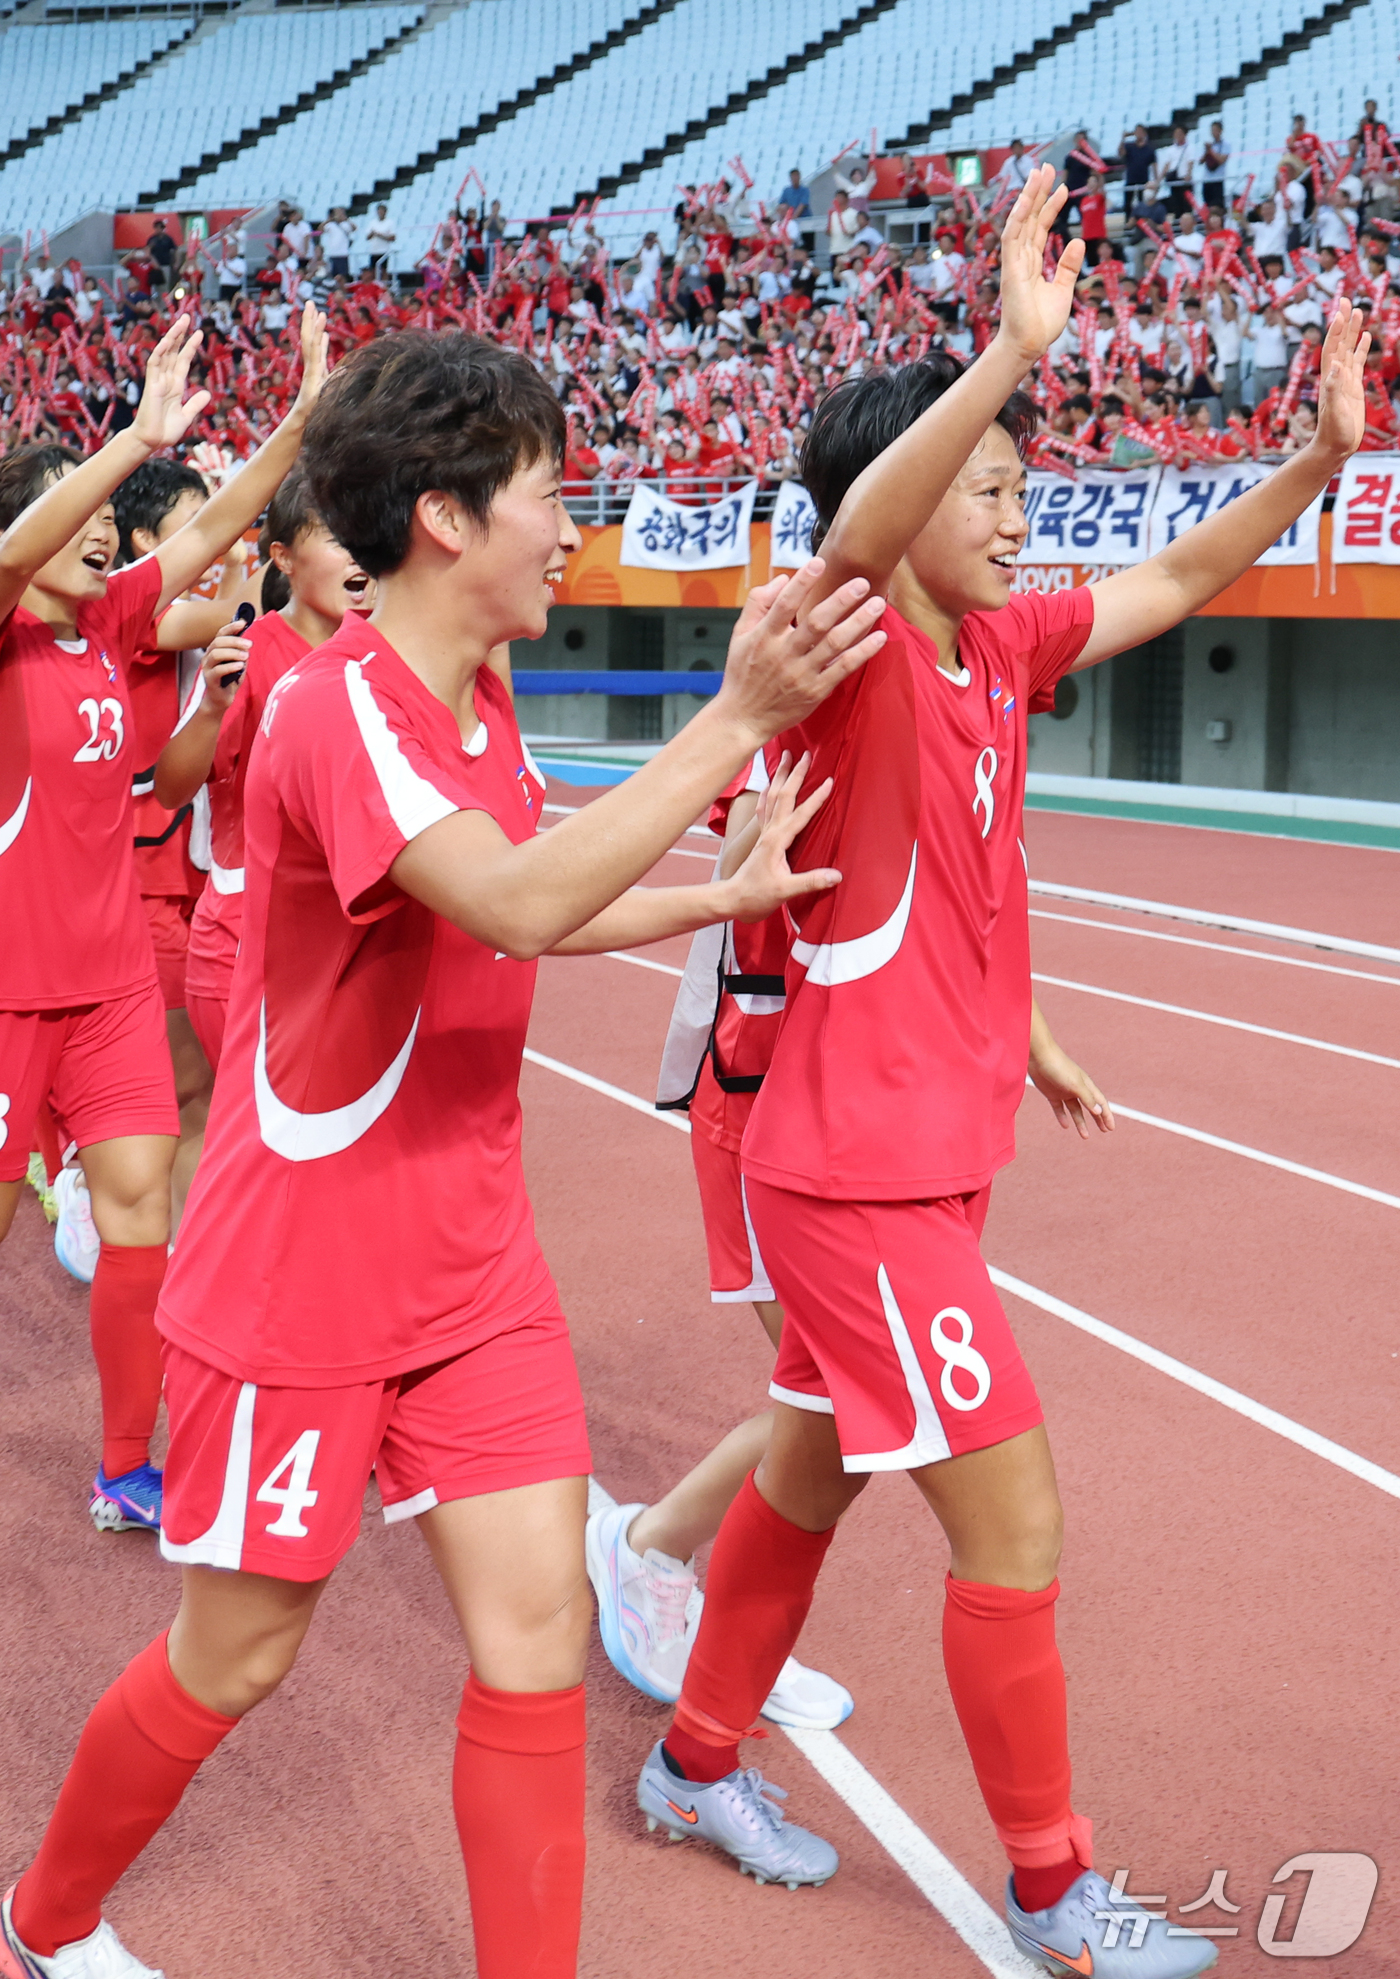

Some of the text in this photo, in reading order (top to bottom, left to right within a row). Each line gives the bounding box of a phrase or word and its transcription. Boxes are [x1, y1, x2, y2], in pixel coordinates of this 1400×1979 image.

[637, 500, 741, 556] 공화국의
[73, 697, 124, 763] 23
[972, 746, 998, 839] 8
[930, 1306, 992, 1412] 8
[256, 1429, 321, 1538] 4
